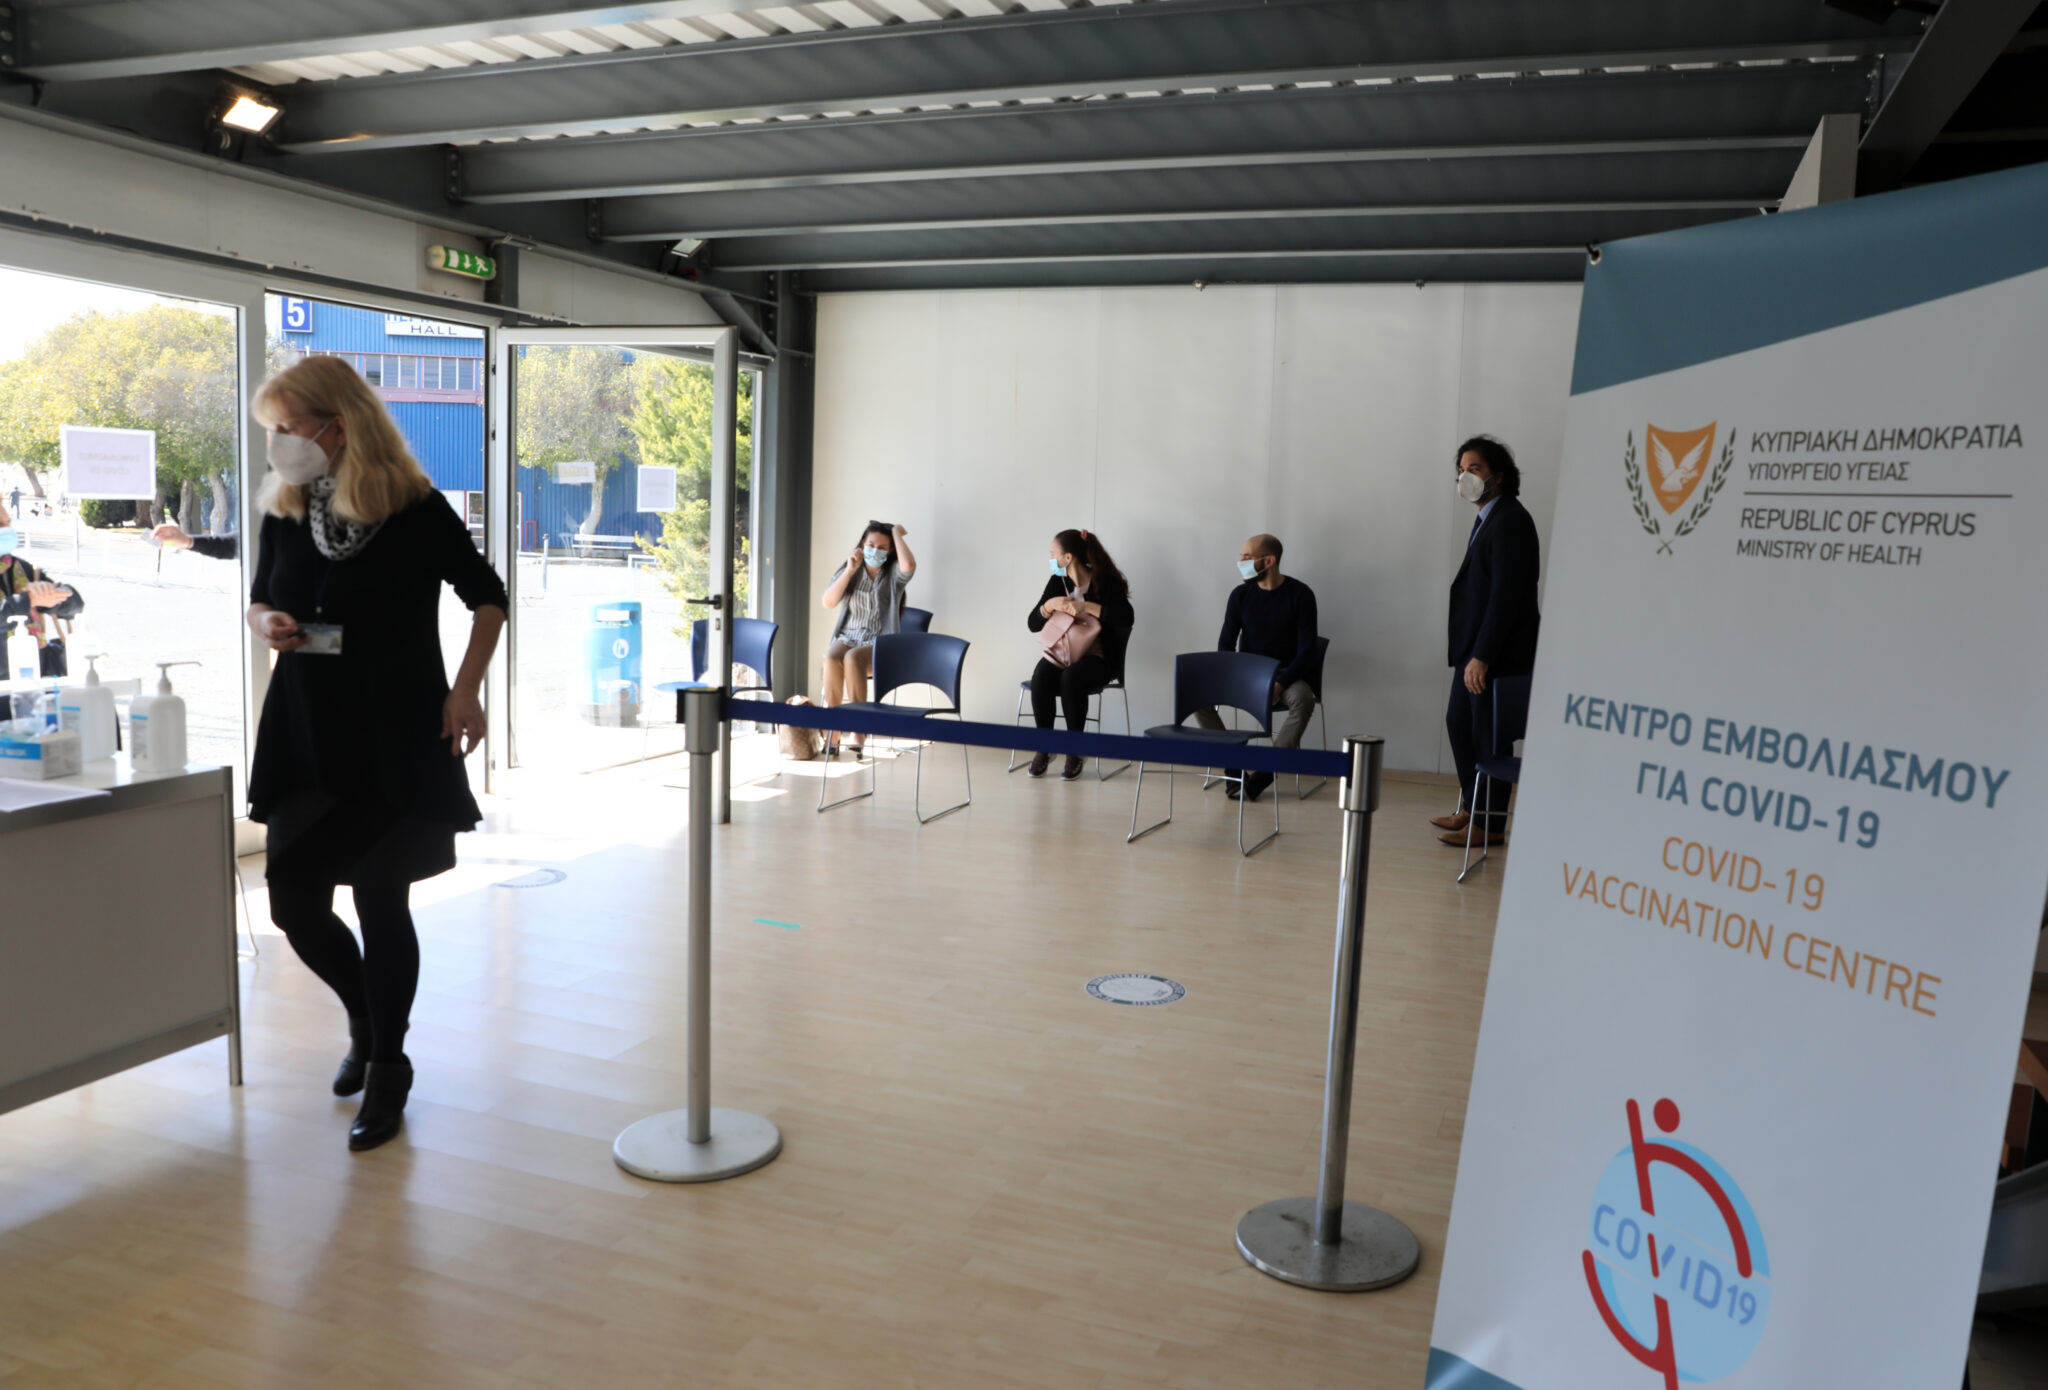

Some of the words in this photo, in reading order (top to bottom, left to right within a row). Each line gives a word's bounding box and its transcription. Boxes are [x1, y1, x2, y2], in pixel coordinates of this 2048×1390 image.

[287, 297, 306, 327] 5
[411, 325, 458, 336] HALL
[1751, 430, 1858, 453] ΚΥΠΡΙΑΚΗ
[1862, 424, 2024, 452] ΔΗΜΟΚΡΑΤΙΑ
[1748, 462, 1842, 481] ΥΠΟΥΡΓΕΙΟ
[1846, 461, 1911, 481] ΥΓΕΙΑΣ
[1740, 507, 1843, 532] REPUBLIC
[1847, 510, 1878, 534] OF
[1881, 511, 1977, 537] CYPRUS
[1736, 539, 1817, 561] MINISTRY
[1819, 542, 1845, 562] OF
[1848, 544, 1923, 566] HEALTH
[1564, 693, 1692, 746] ΚΕΝΤΡΟ
[1702, 717, 2011, 810] ΕΜΒΟΛΙΑΣΜΟΥ
[1636, 762, 1688, 805] ΓΙΑ
[1700, 777, 1880, 849] COVID-19
[1662, 836, 1825, 911] COVID-19
[1563, 862, 1774, 960] VACCINATION
[1783, 932, 1942, 1018] CENTRE
